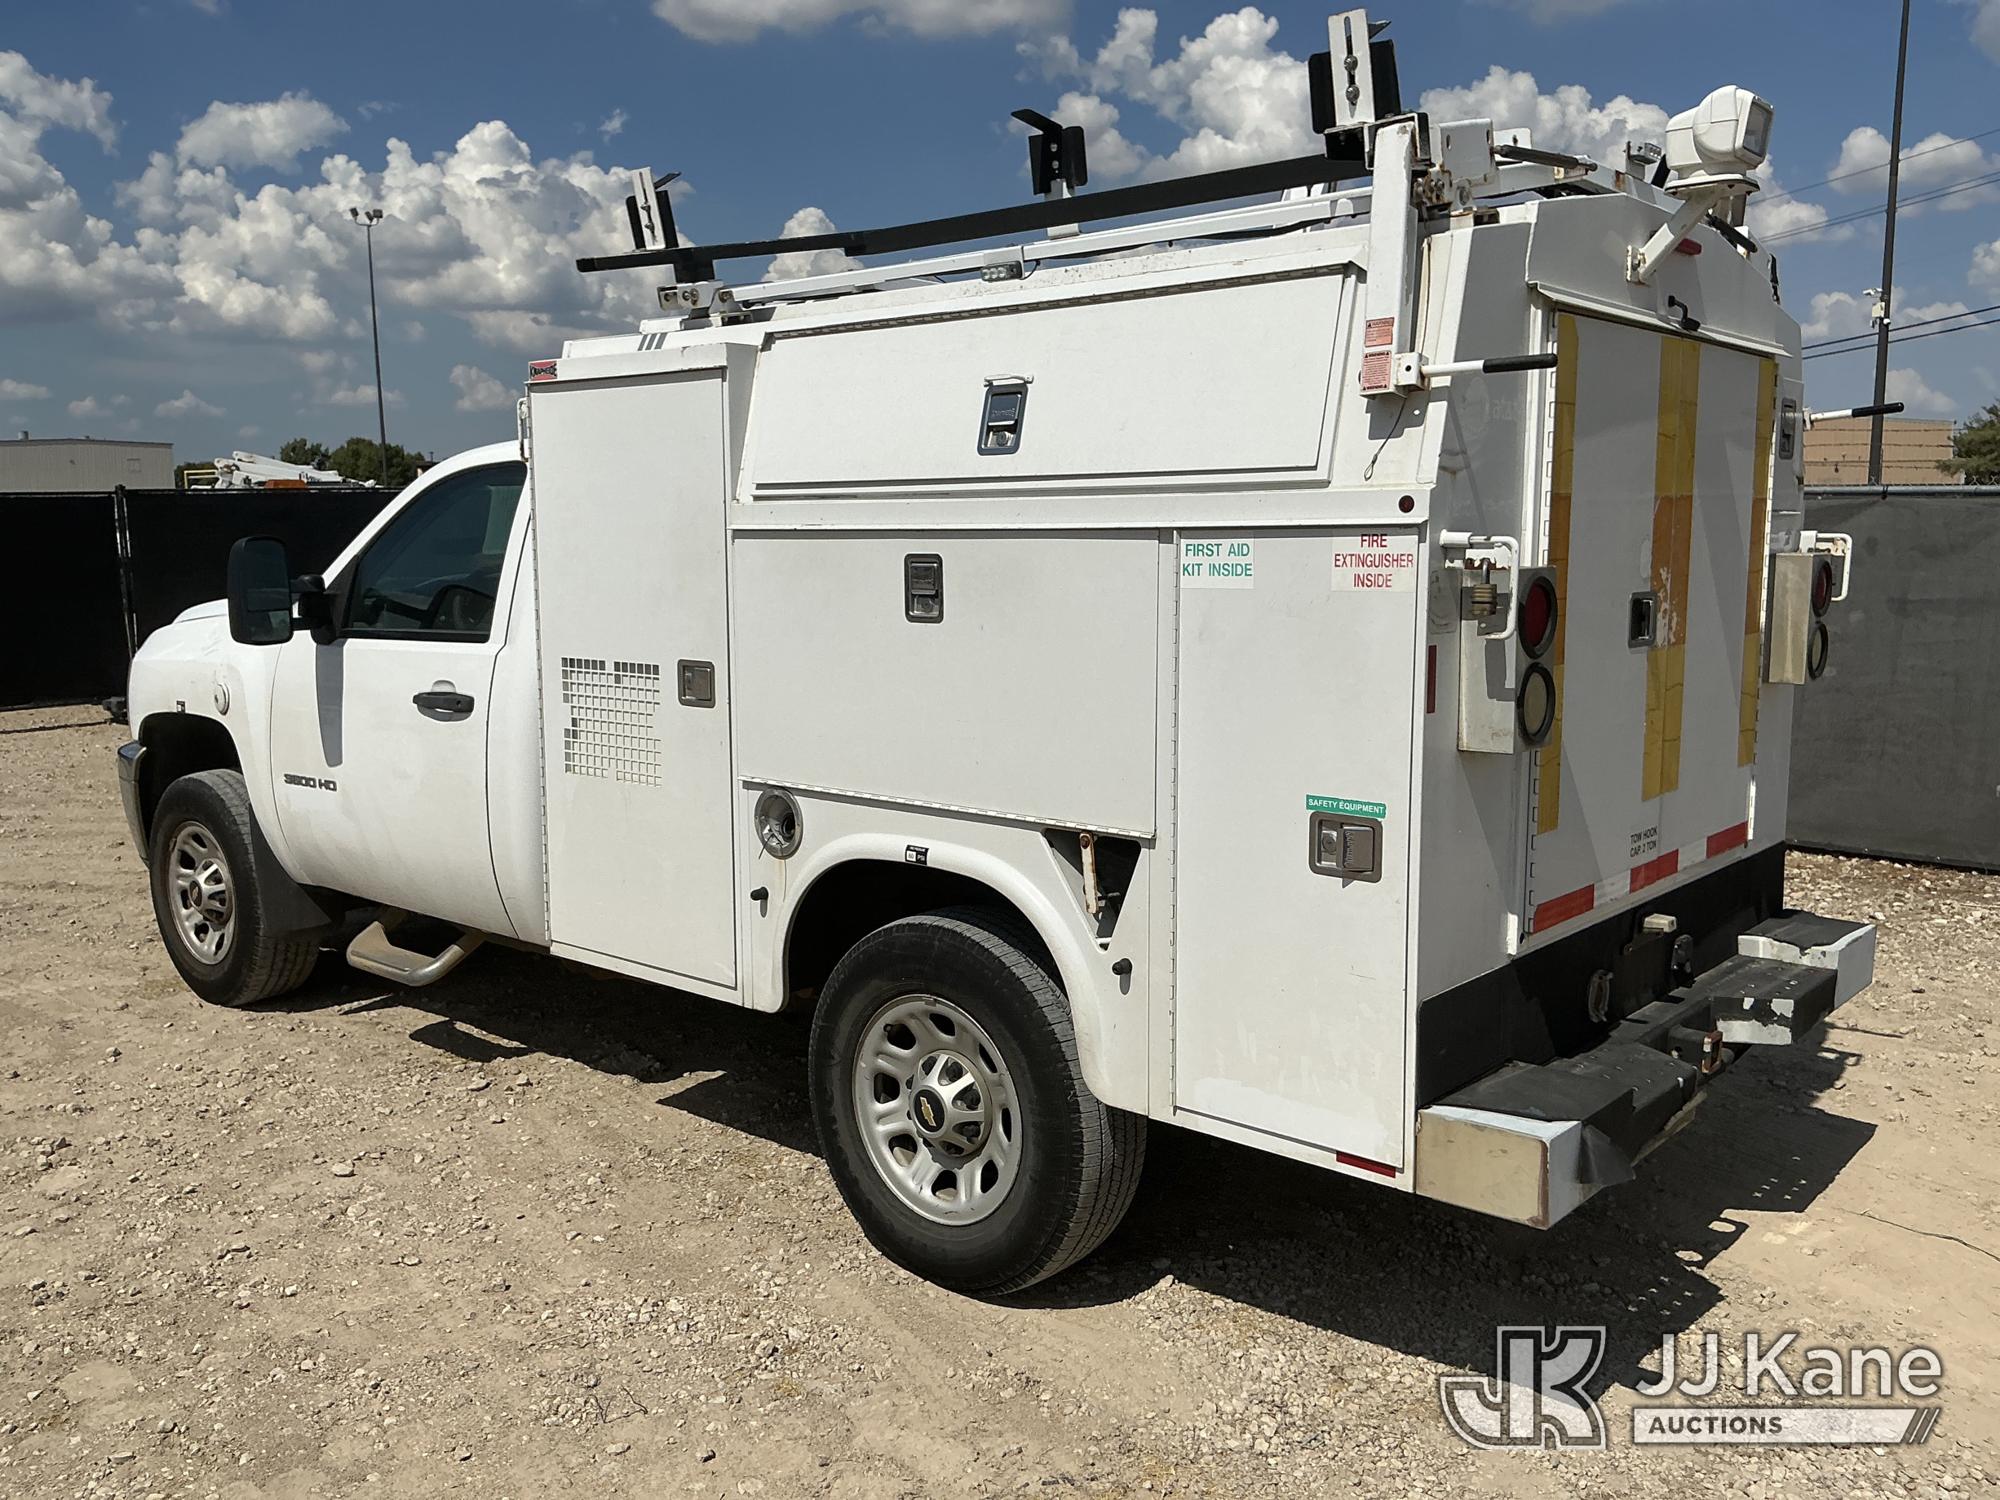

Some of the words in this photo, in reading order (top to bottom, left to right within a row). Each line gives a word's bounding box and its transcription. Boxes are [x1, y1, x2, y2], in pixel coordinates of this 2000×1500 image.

[1361, 534, 1388, 548] FIRE
[1185, 543, 1223, 557] FIRST
[1227, 543, 1250, 557] AID
[1334, 553, 1414, 569] EXTINGUISHER
[1183, 563, 1203, 577] KIT
[1208, 563, 1253, 577] INSIDE
[1353, 573, 1393, 588] INSIDE
[318, 778, 337, 791] HD
[1308, 798, 1337, 808] SAFETY
[1338, 801, 1385, 814] EQUIPMENT
[1630, 833, 1642, 844] TOW
[1643, 827, 1657, 839] HOOK
[1647, 840, 1657, 851] TON
